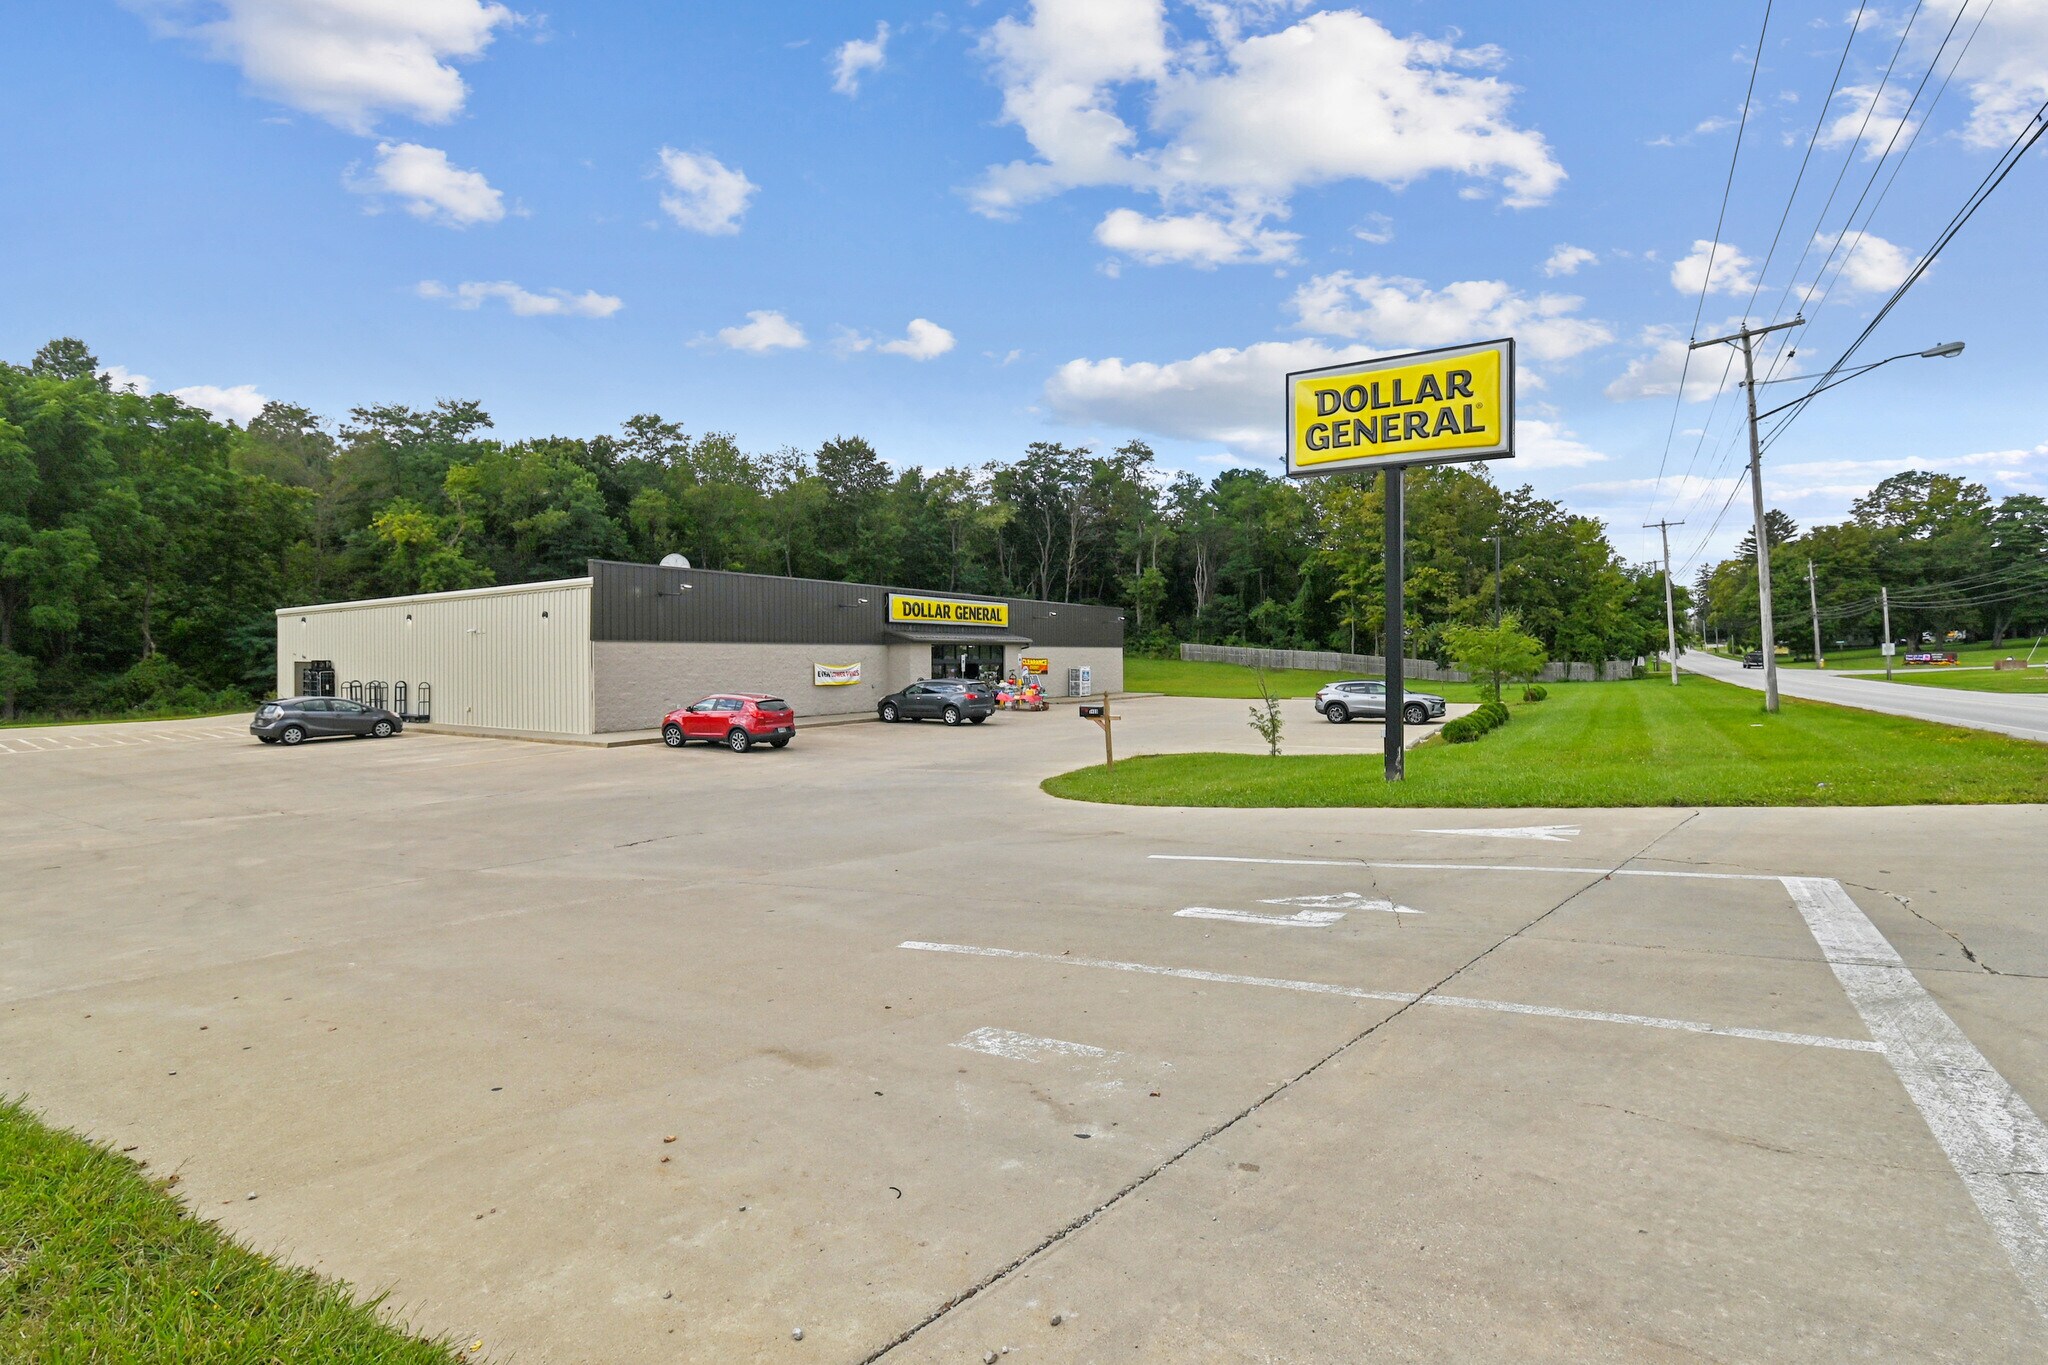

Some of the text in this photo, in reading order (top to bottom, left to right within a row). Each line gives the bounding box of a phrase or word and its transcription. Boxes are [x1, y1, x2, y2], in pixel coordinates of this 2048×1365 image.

[1314, 369, 1474, 417] DOLLAR
[1305, 404, 1486, 451] GENERAL
[902, 601, 1003, 622] DOLLAR GENERAL
